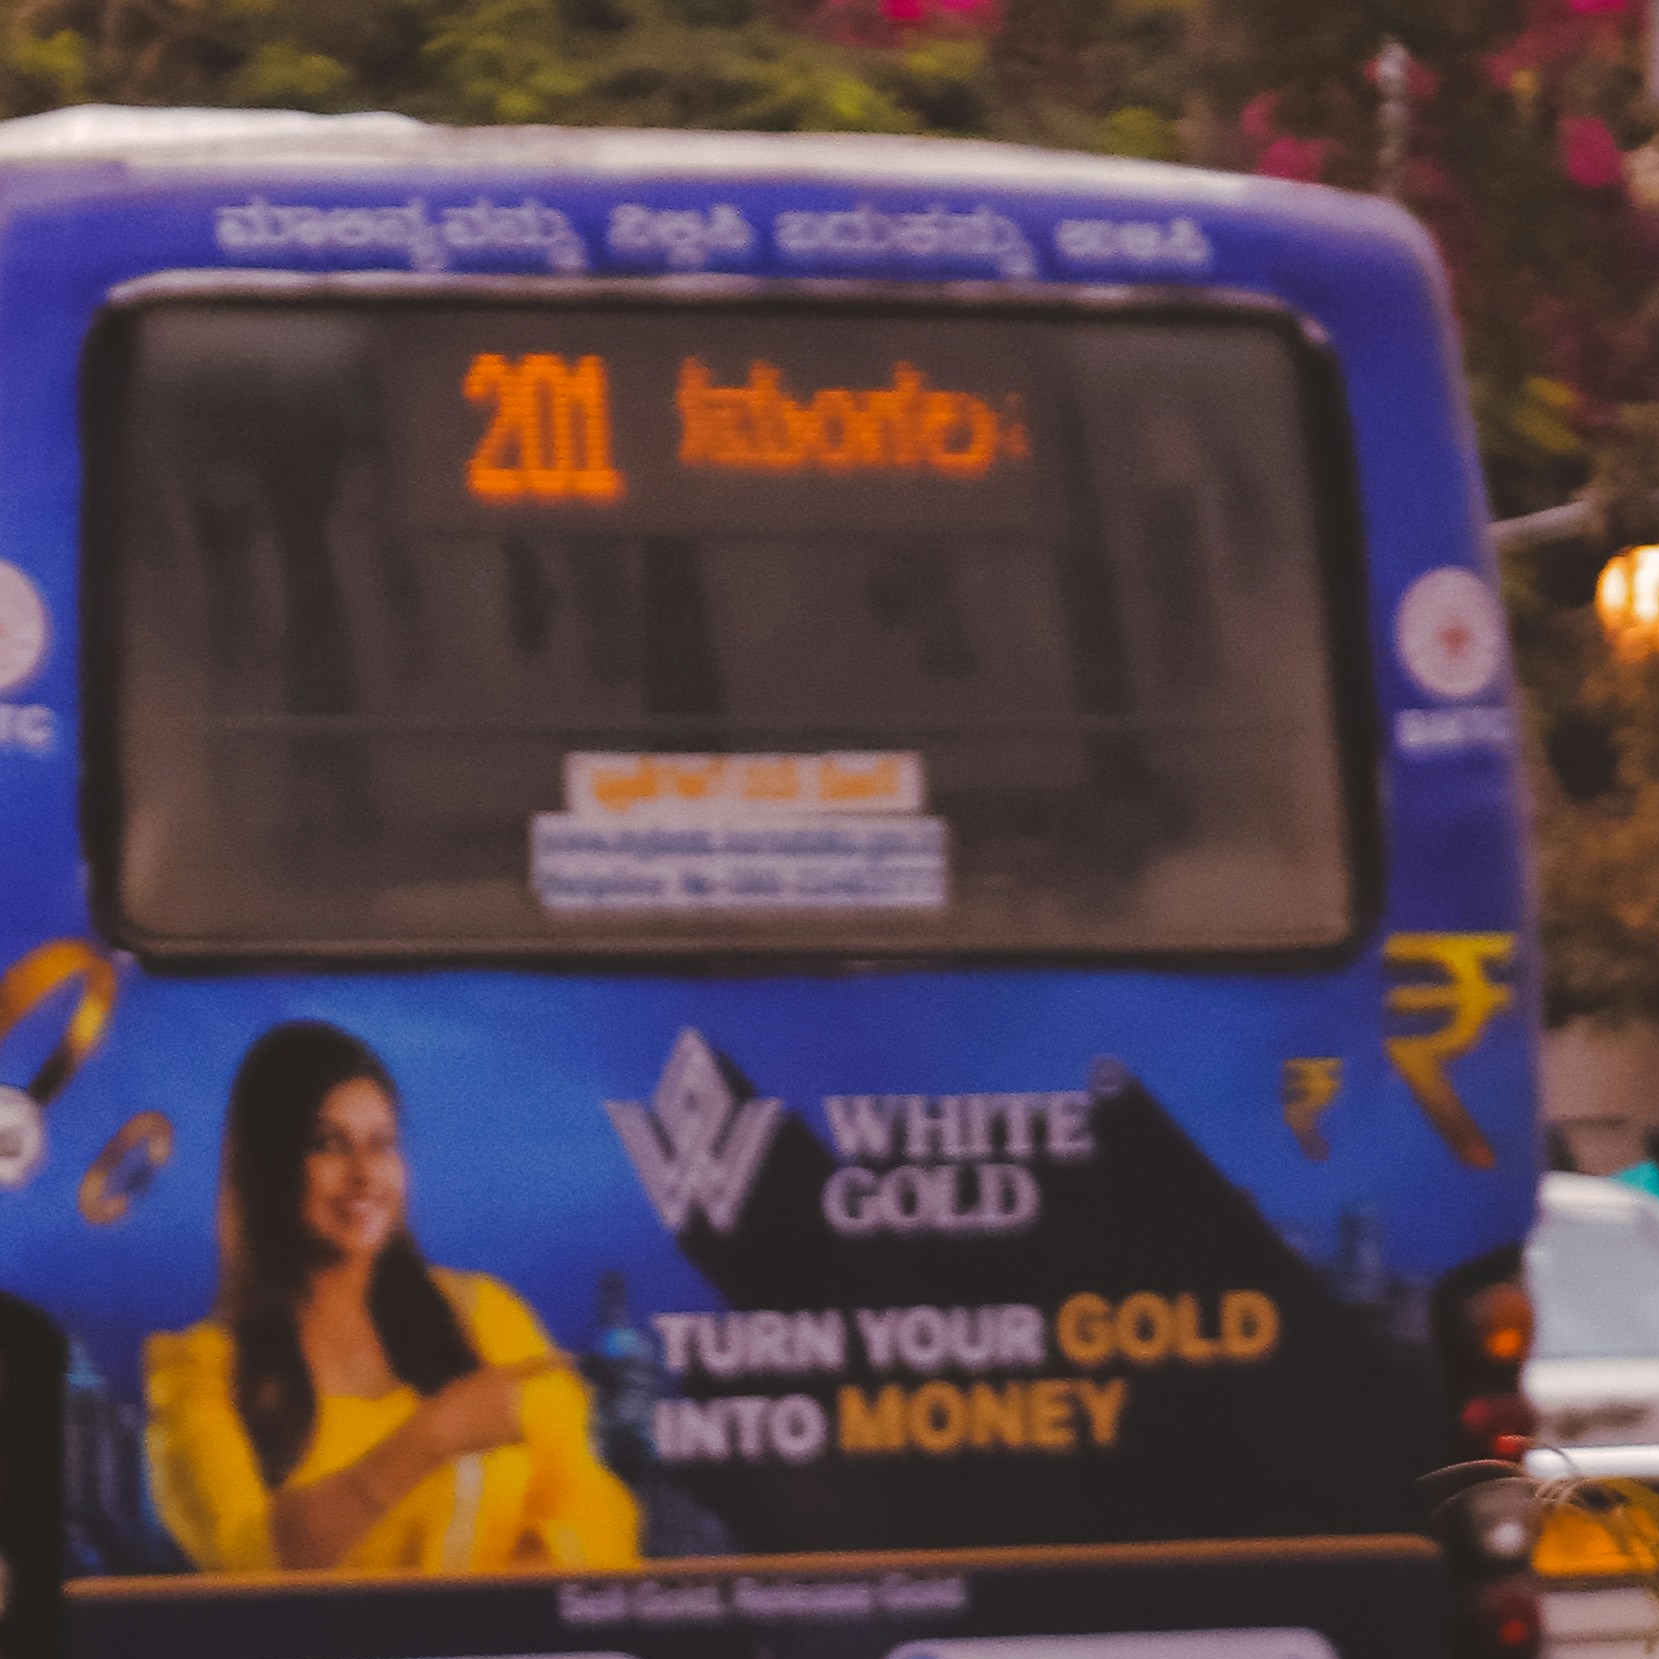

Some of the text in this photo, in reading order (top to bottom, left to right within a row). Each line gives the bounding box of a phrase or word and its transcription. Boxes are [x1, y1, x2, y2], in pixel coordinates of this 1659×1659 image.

[823, 1091, 1095, 1160] WHITE
[822, 1162, 1042, 1236] GOLD
[655, 1289, 1281, 1374] TURN YOUR GOLD
[655, 1376, 1128, 1462] INTO MONEY
